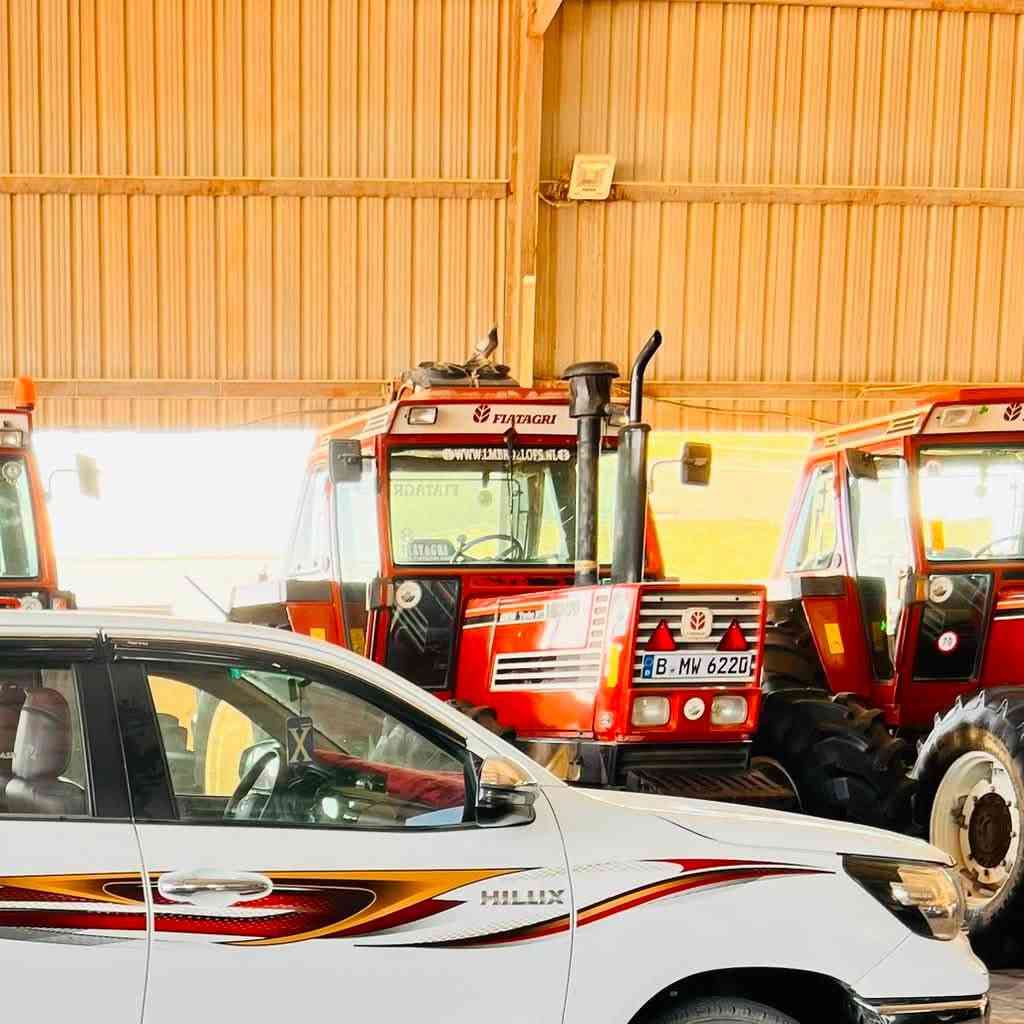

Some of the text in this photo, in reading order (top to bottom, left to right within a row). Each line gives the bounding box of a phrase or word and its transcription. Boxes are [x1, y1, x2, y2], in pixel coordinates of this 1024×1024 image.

[492, 413, 558, 425] FIATAGRI
[656, 656, 748, 675] B MW 6220
[479, 889, 564, 905] HILUX
